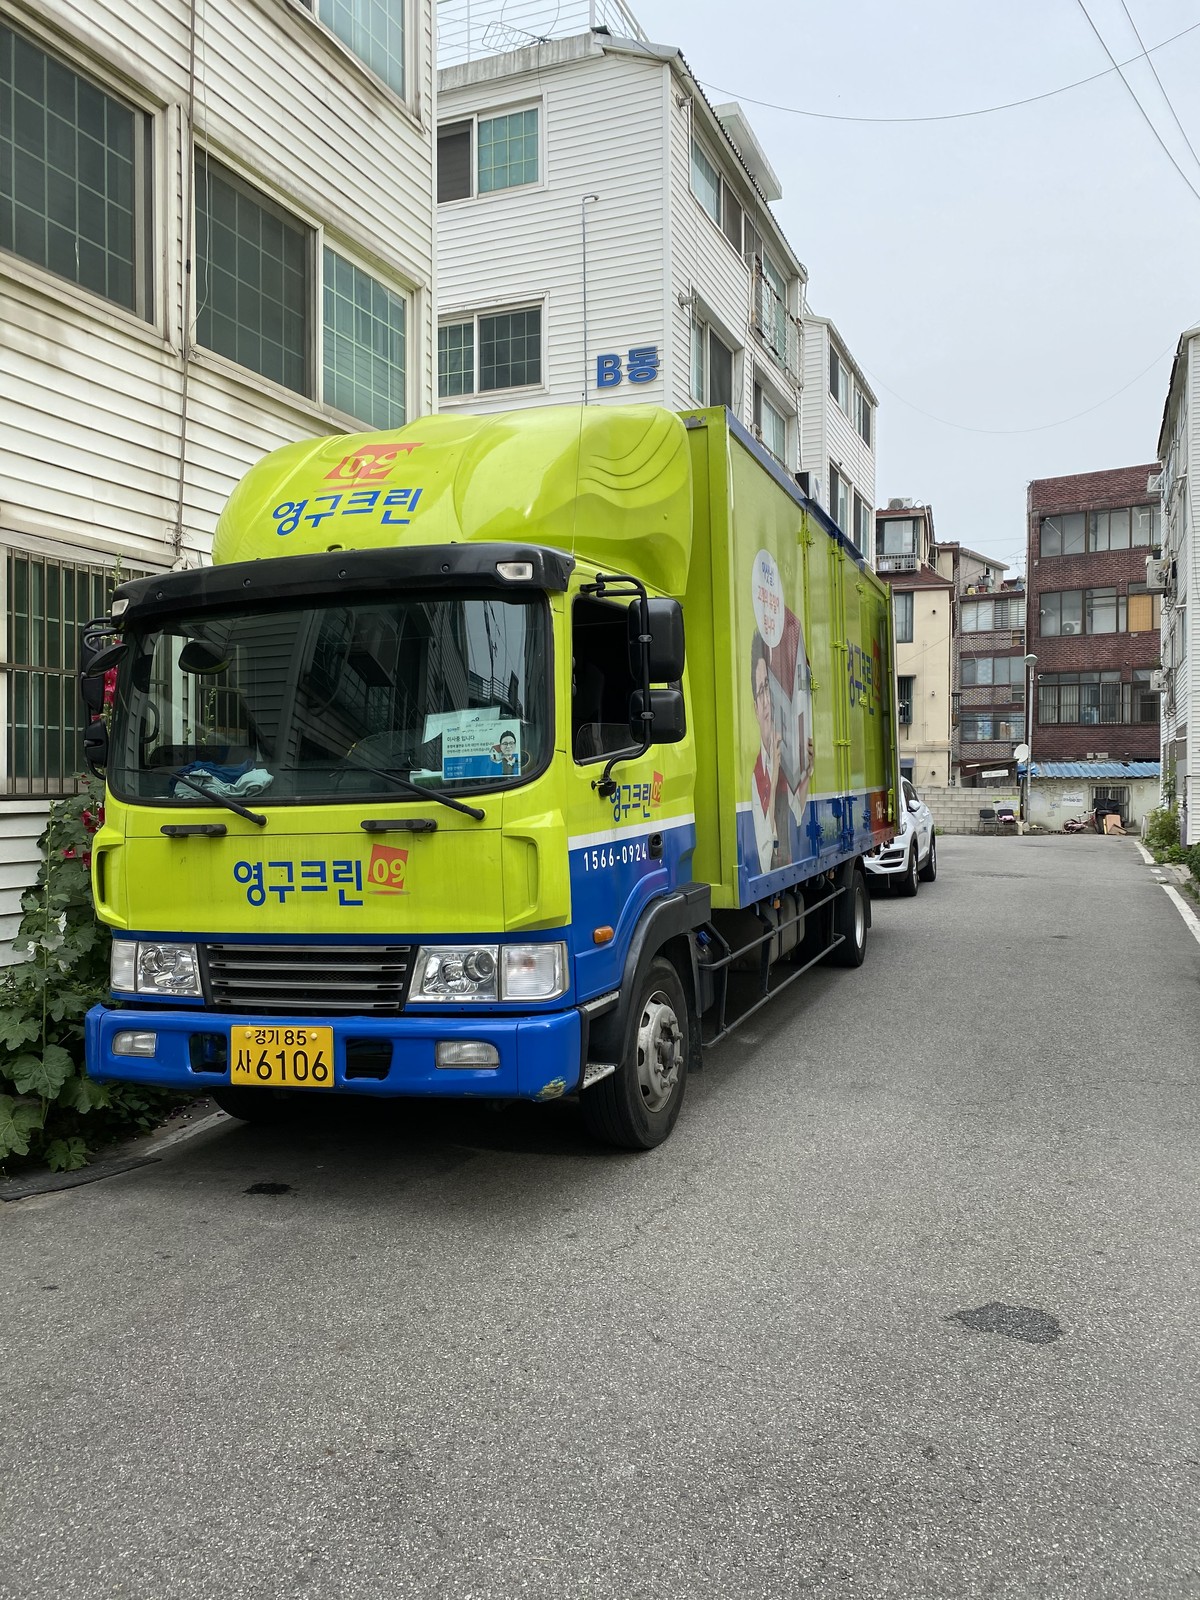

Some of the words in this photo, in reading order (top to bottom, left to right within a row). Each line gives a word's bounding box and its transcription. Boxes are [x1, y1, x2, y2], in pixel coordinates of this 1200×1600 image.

[597, 346, 660, 388] B동
[272, 488, 424, 536] 영구크린
[609, 783, 651, 822] 영구크린
[583, 842, 647, 872] 1566-0924
[233, 860, 363, 907] 영구크린
[372, 858, 406, 884] 09
